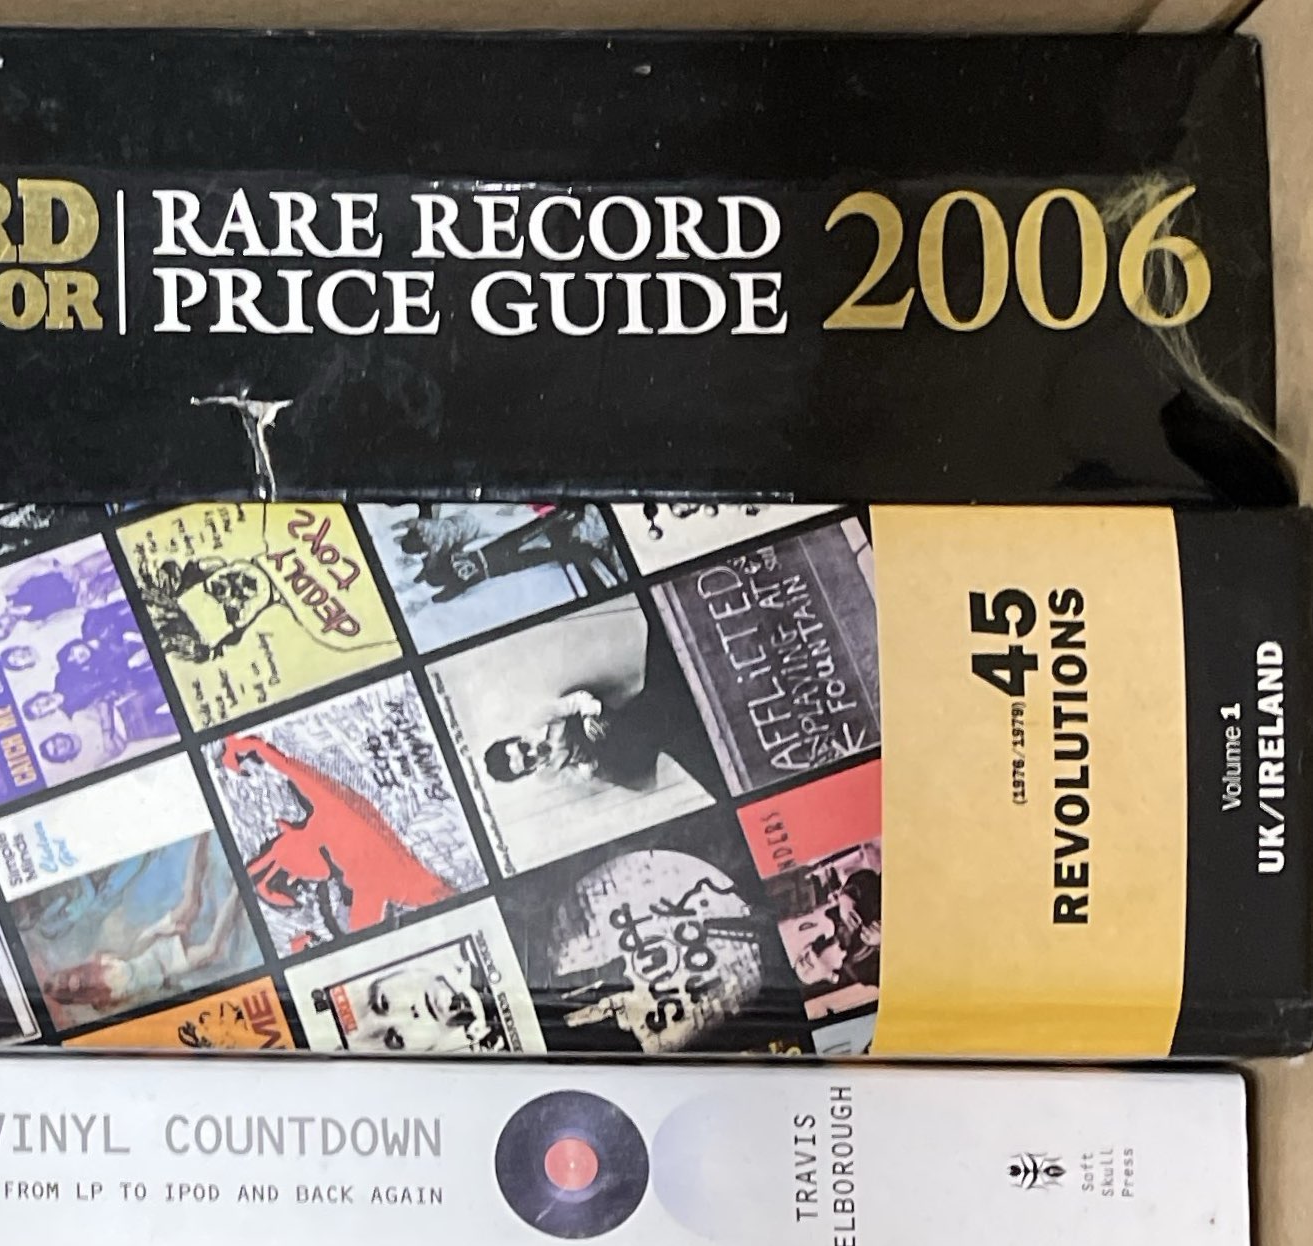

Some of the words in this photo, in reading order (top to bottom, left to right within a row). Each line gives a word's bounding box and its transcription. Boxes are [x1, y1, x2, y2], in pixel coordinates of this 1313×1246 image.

[152, 188, 383, 258] RARE
[411, 193, 782, 261] RECORD
[822, 185, 1212, 332] 2006
[152, 267, 440, 335] PRICE
[470, 271, 788, 337] GUIDE
[969, 588, 1039, 697] 45
[1220, 703, 1241, 721] 1
[1012, 702, 1028, 804] (1976/1979)
[1048, 587, 1091, 925] REVOLUTIONS
[1221, 729, 1242, 812] Volume
[1256, 640, 1285, 874] UK/IRELAND
[165, 1115, 442, 1158] COUNTDOWN
[796, 1112, 819, 1222] TRAVIS
[1081, 1152, 1095, 1192] Soft
[1102, 1147, 1115, 1197] Skull
[1121, 1147, 1135, 1198] Press
[4, 1181, 59, 1201] FROM
[76, 1182, 103, 1201] LP
[120, 1182, 147, 1201] TO
[165, 1184, 220, 1203] IPOD
[238, 1185, 279, 1203] AND
[296, 1186, 354, 1204] BACK
[371, 1186, 443, 1205] AGAIN
